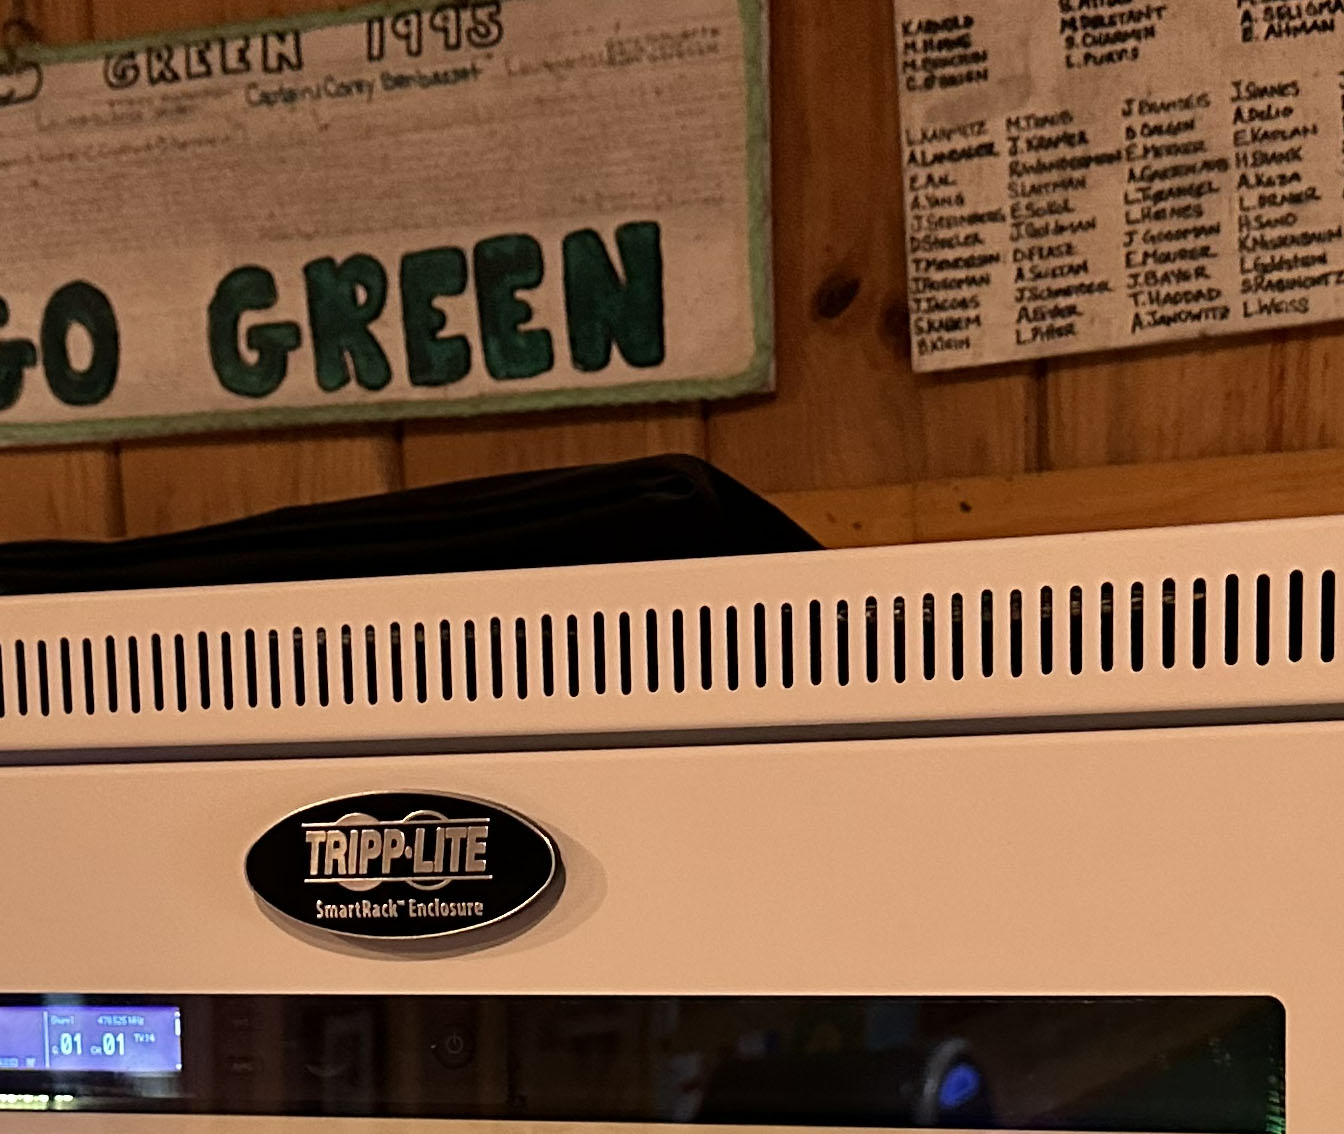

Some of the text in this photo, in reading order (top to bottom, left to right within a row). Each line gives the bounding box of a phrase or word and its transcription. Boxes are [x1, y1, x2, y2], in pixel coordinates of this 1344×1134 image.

[103, 30, 305, 90] GREEN
[365, 2, 506, 63] 1995
[207, 219, 666, 399] GREEN
[409, 898, 485, 919] Enclosure
[60, 1033, 83, 1056] 01
[102, 1033, 126, 1056] 01
